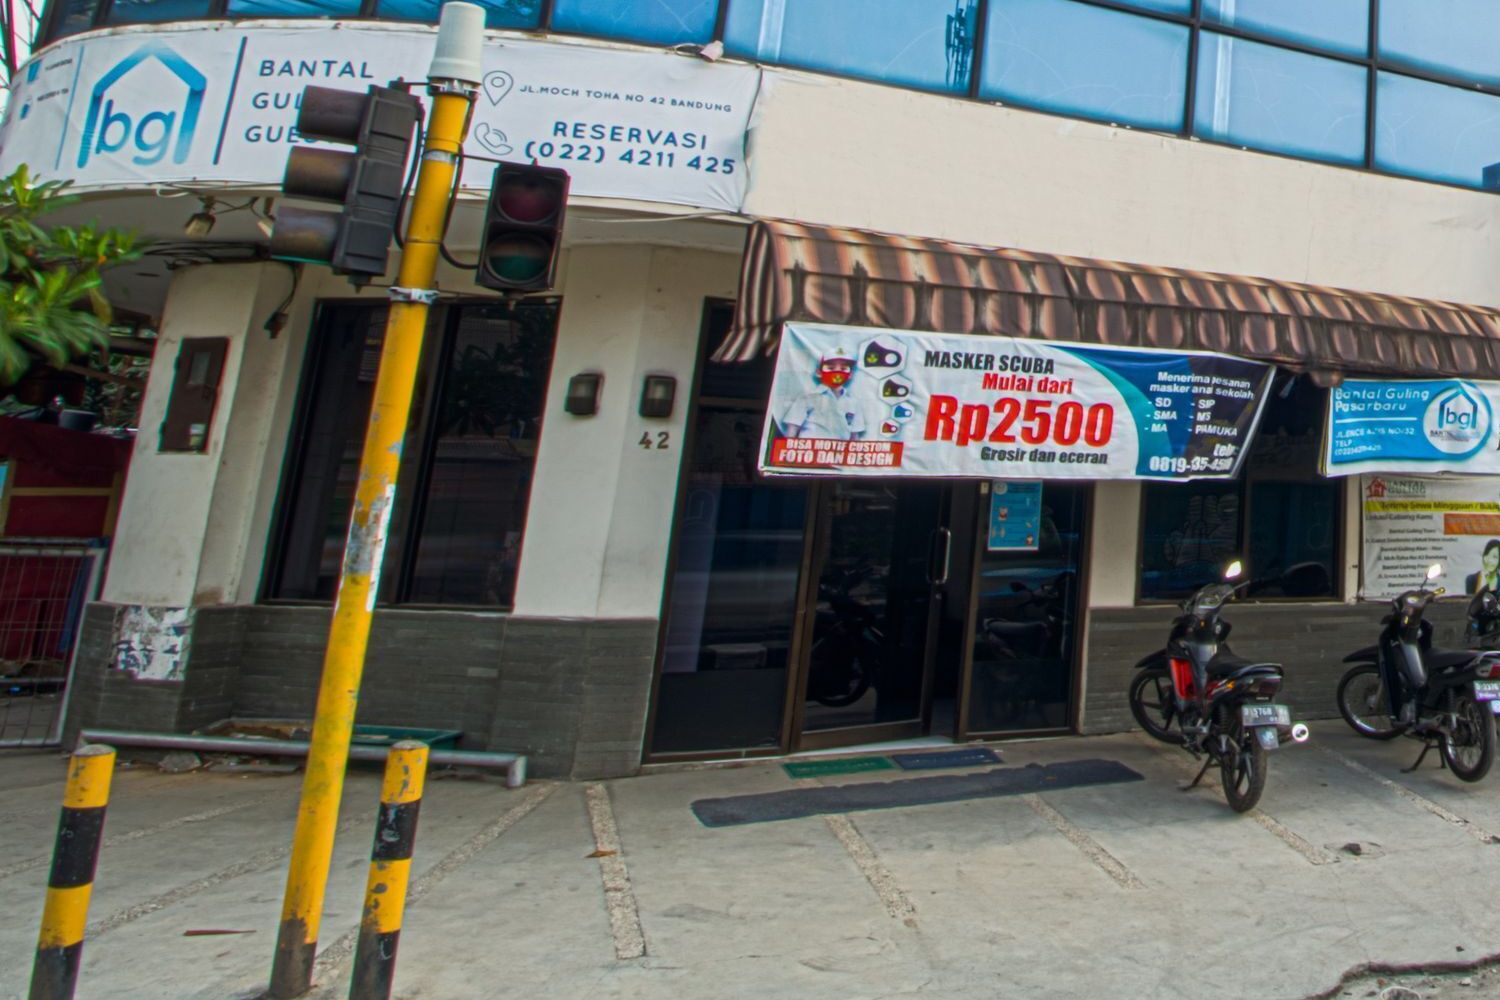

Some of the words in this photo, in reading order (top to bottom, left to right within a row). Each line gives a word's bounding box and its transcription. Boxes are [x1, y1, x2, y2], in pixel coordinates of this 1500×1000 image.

[259, 60, 374, 78] BANTAL
[519, 85, 579, 97] JL.MOCH
[586, 90, 620, 100] TOHA
[625, 93, 644, 103] NO
[649, 96, 665, 105] 42
[670, 98, 732, 112] BANDUNG
[95, 99, 176, 165] bg
[553, 121, 707, 150] RESERVASI
[525, 141, 606, 163] (022)
[619, 148, 674, 168] 4211
[687, 156, 735, 174] 425
[924, 350, 995, 370] MASKER
[998, 355, 1054, 374] SCUBA
[982, 373, 1034, 392] Mulai
[1037, 377, 1073, 394] dari
[1158, 371, 1210, 384] Menerima
[1150, 383, 1190, 392] masker
[1192, 385, 1213, 394] ana
[1215, 388, 1255, 400] sekolah
[1335, 388, 1381, 400] Bantal
[1385, 388, 1430, 401] Guling
[1155, 397, 1172, 407] SD
[1335, 401, 1407, 413] Pasarbaru
[924, 394, 1114, 447] Rp2500
[1153, 410, 1177, 420] SMA
[1445, 407, 1471, 429] bg
[1151, 423, 1168, 432] MA
[638, 431, 669, 450] 42
[786, 439, 811, 450] BISA
[814, 440, 848, 451] MOTIF
[848, 441, 891, 452] CUSTOM
[778, 449, 814, 463] FOTO
[816, 451, 844, 464] DAN
[846, 453, 894, 466] DESIGN
[980, 446, 1025, 462] Grosir
[1029, 449, 1056, 463] dan
[1059, 453, 1108, 465] eceran
